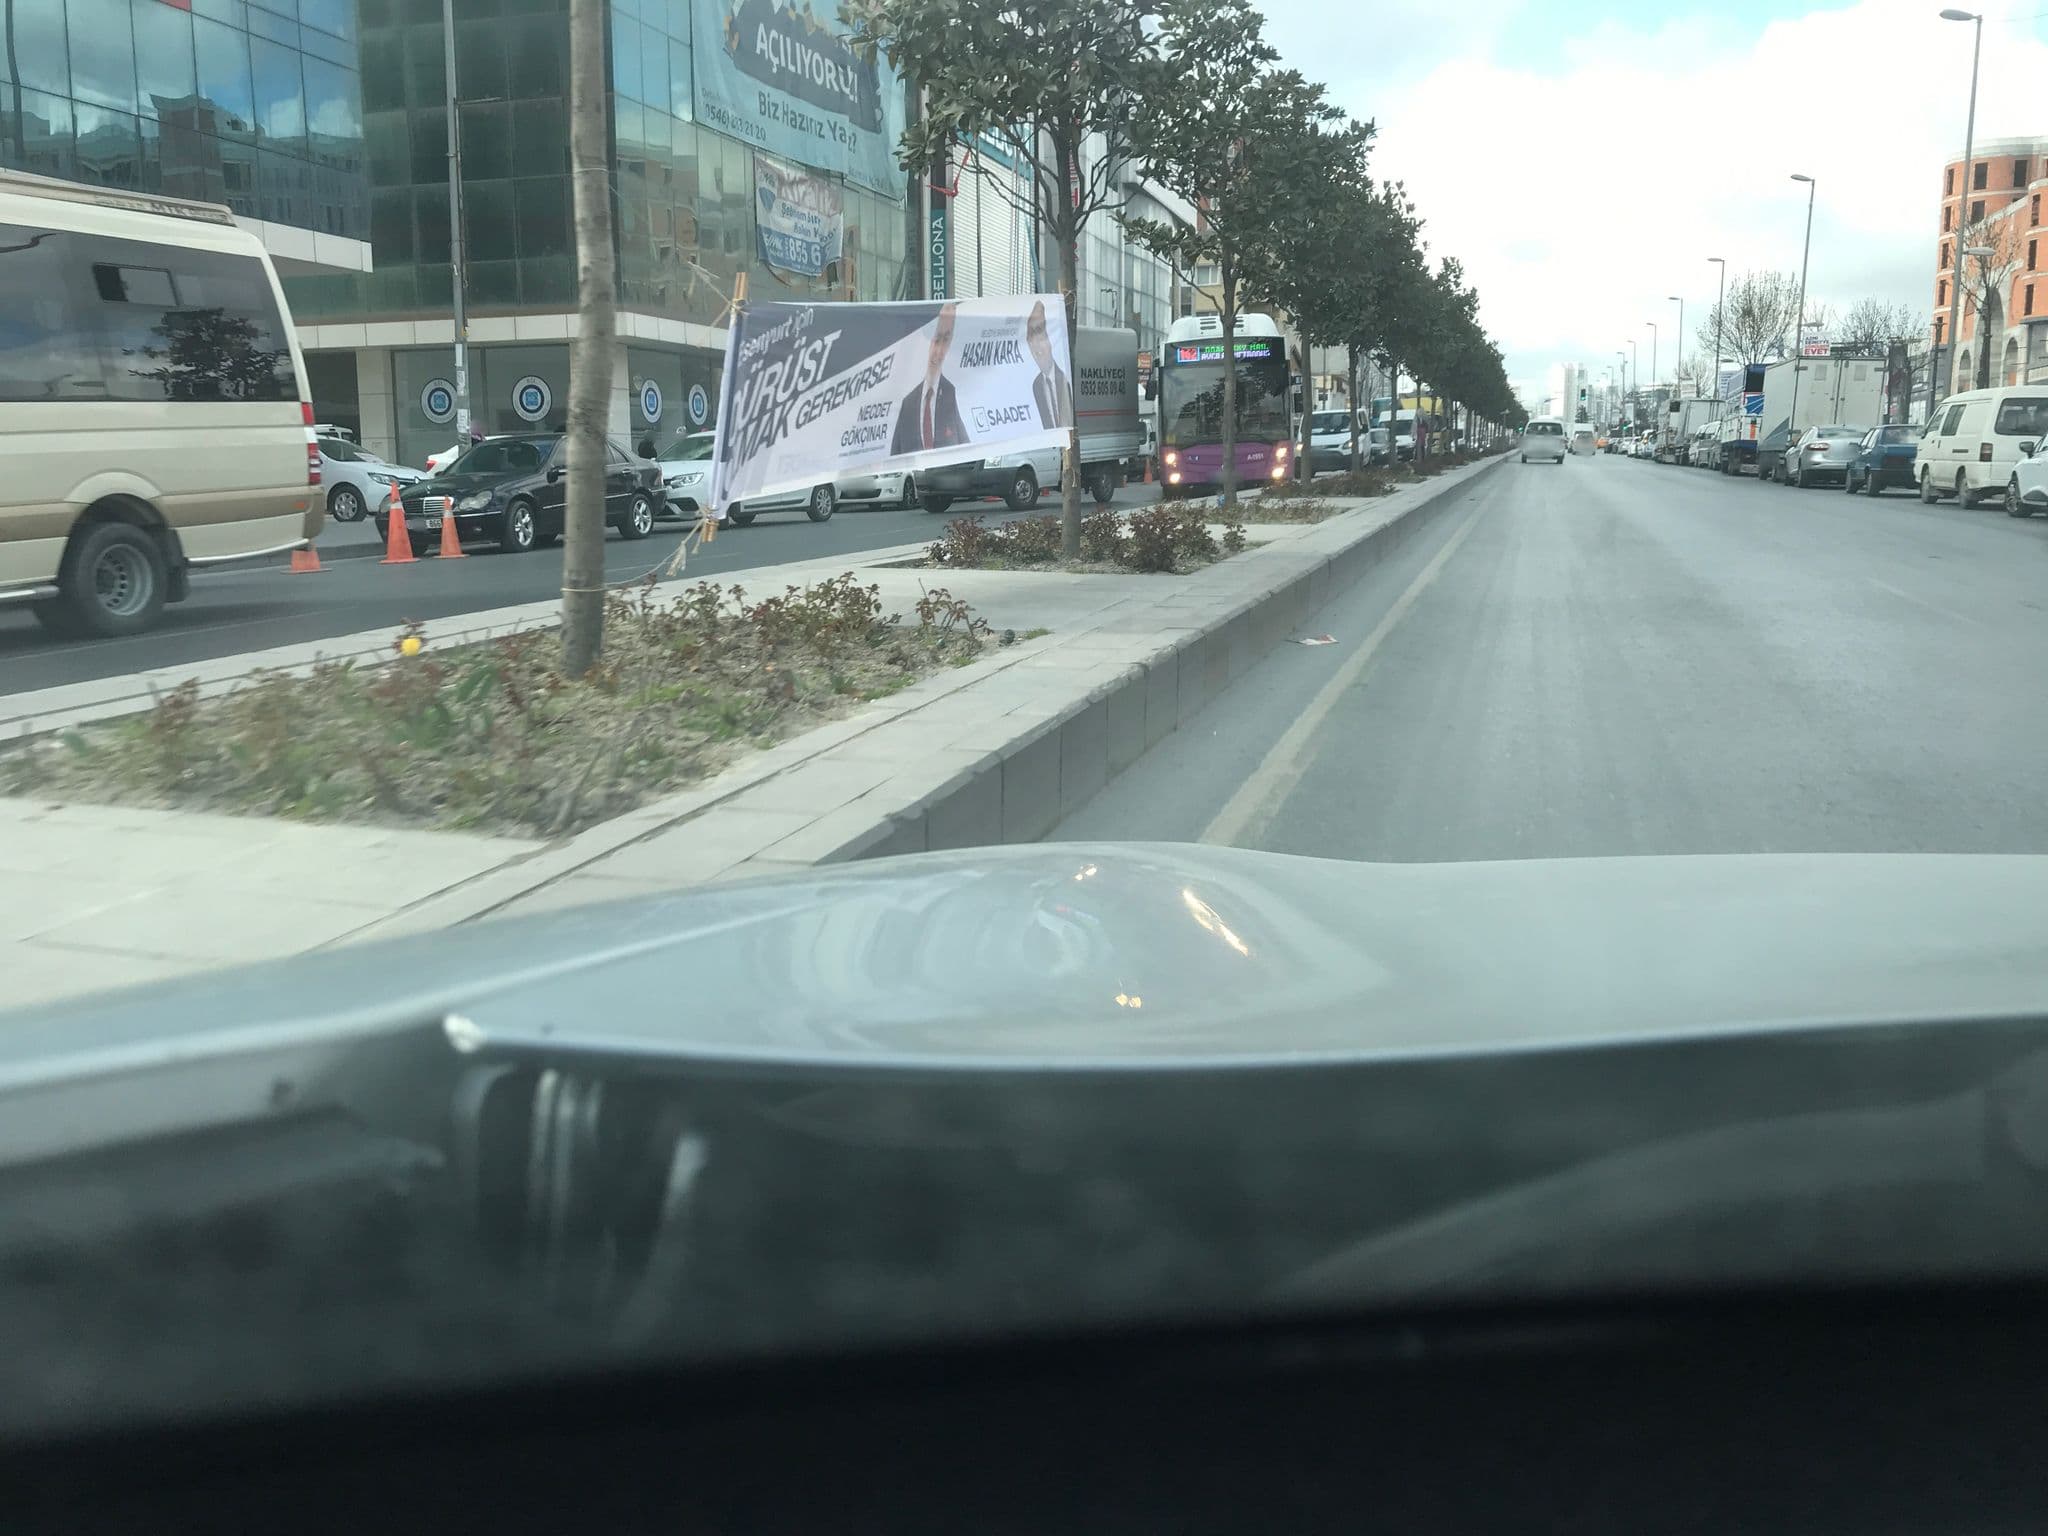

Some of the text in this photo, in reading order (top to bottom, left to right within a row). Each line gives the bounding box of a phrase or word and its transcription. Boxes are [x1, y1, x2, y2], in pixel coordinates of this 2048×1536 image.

[758, 90, 780, 121] Biz
[782, 101, 825, 139] Hazırız
[932, 216, 945, 300] BELLONA
[960, 339, 1025, 369] HASAN KARA
[1080, 366, 1126, 379] NAKLİYECİ
[857, 401, 893, 422] NECDET
[987, 404, 1032, 426] SAADET
